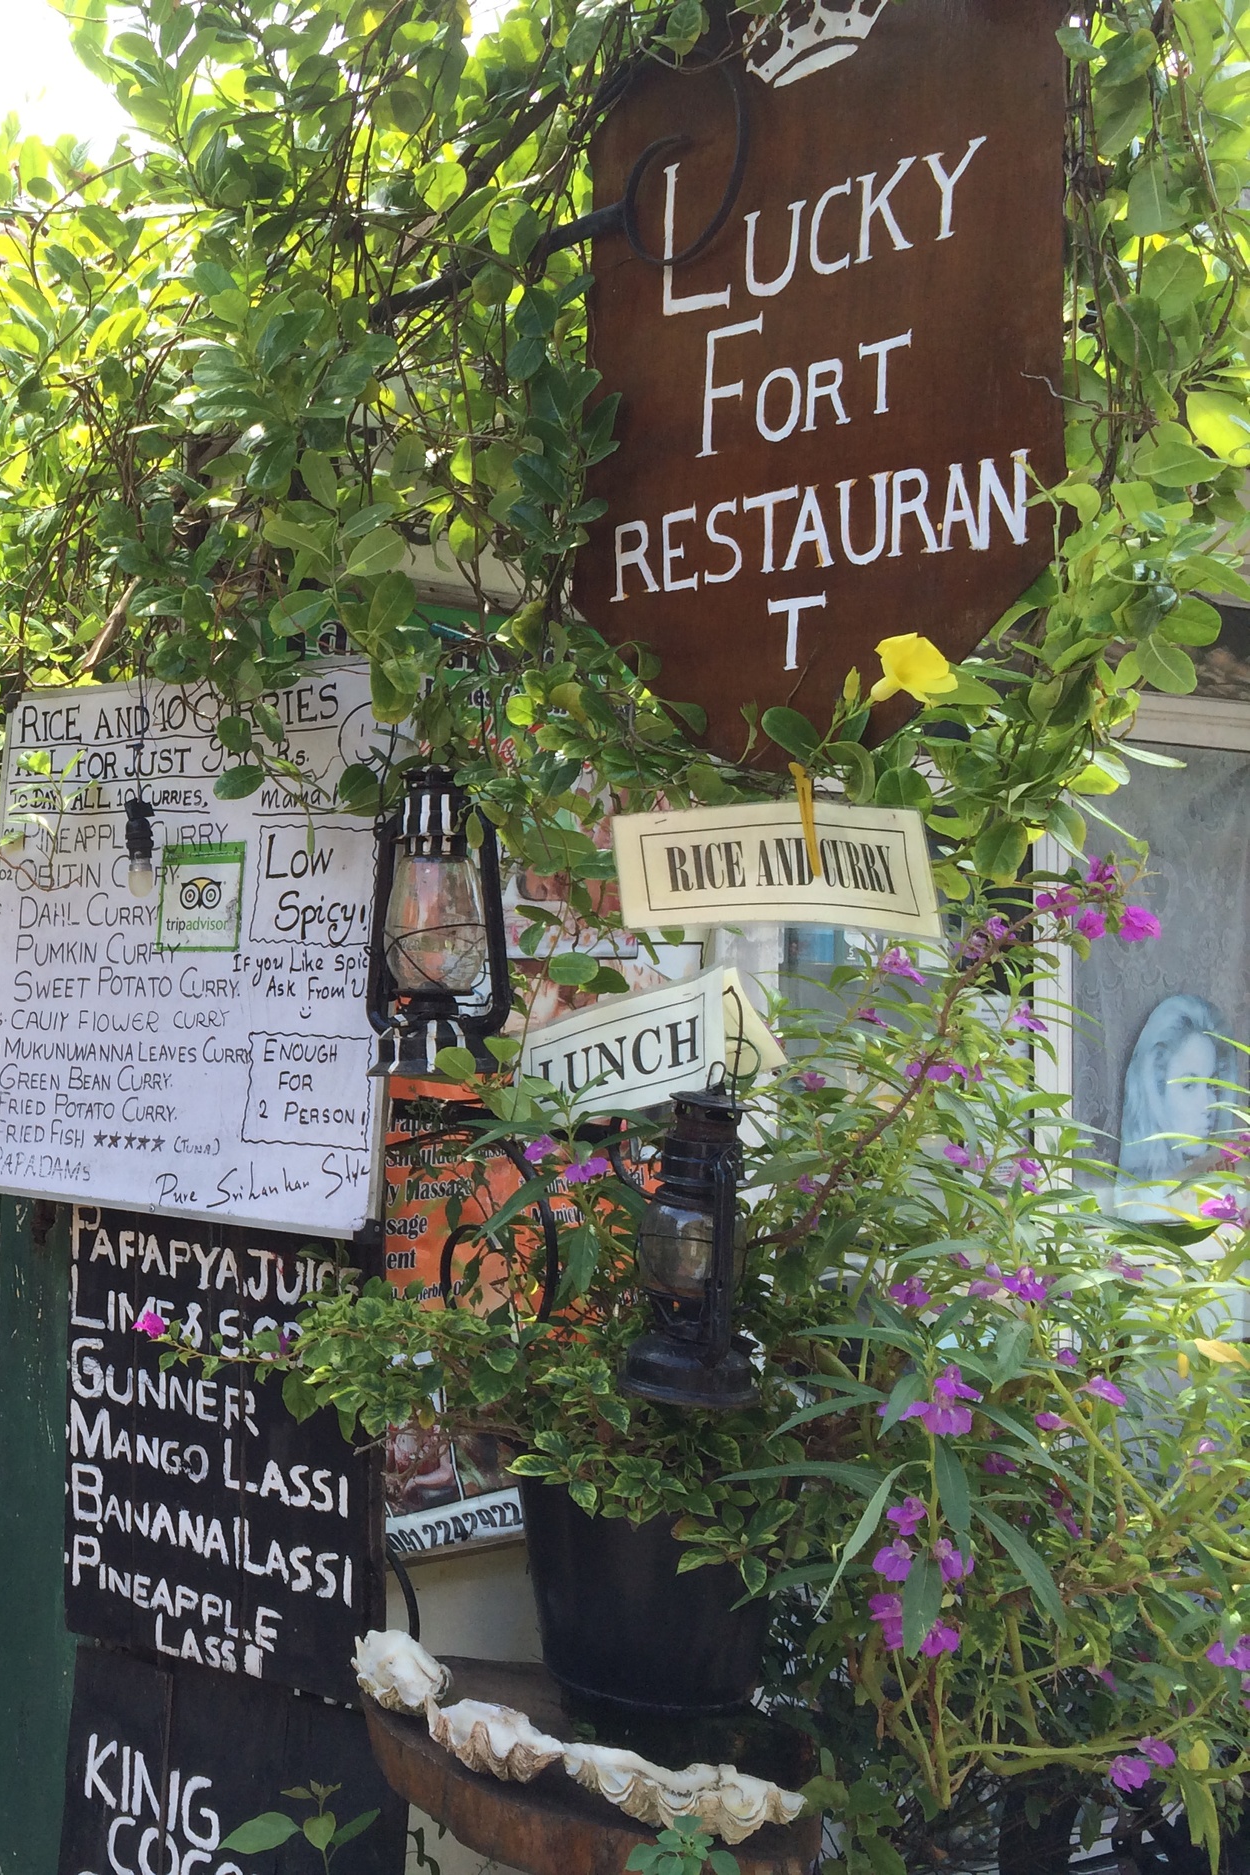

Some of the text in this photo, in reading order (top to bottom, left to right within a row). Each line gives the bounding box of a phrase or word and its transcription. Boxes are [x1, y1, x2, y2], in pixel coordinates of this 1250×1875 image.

[662, 135, 987, 316] LUCKY
[694, 310, 913, 459] FORT
[609, 448, 1032, 603] RESTAURAN
[766, 590, 826, 671] T
[20, 704, 82, 744] RICE
[94, 706, 150, 740] AND
[158, 695, 187, 732] 10
[124, 744, 192, 777] JUST
[22, 822, 126, 854] PINEAPPL
[664, 837, 898, 896] RICE AND CURRY
[19, 896, 80, 930] DAHL
[166, 917, 229, 934] tripadvisor
[16, 933, 181, 967] PUMKIN CURRY
[14, 970, 91, 1002] SWEET
[98, 966, 172, 998] POTATO
[173, 1009, 230, 1030] CURRY
[138, 1040, 197, 1063] LEAVES
[263, 1038, 338, 1064] ENOUGH
[538, 1014, 699, 1106] LUNCH
[0, 1063, 61, 1091] GREEN
[68, 1066, 111, 1091] BEAN
[278, 1070, 314, 1092] FOR
[55, 1093, 115, 1120] POTATO
[258, 1099, 269, 1119] 2
[50, 1119, 85, 1148] FISH
[155, 1173, 199, 1207] Pure
[70, 1338, 260, 1437] GUNNER
[69, 1398, 349, 1518] MANGO LASSI
[71, 1462, 230, 1566] BANANA
[71, 1534, 284, 1653] PINEAPPLE
[84, 1732, 221, 1852] KING
